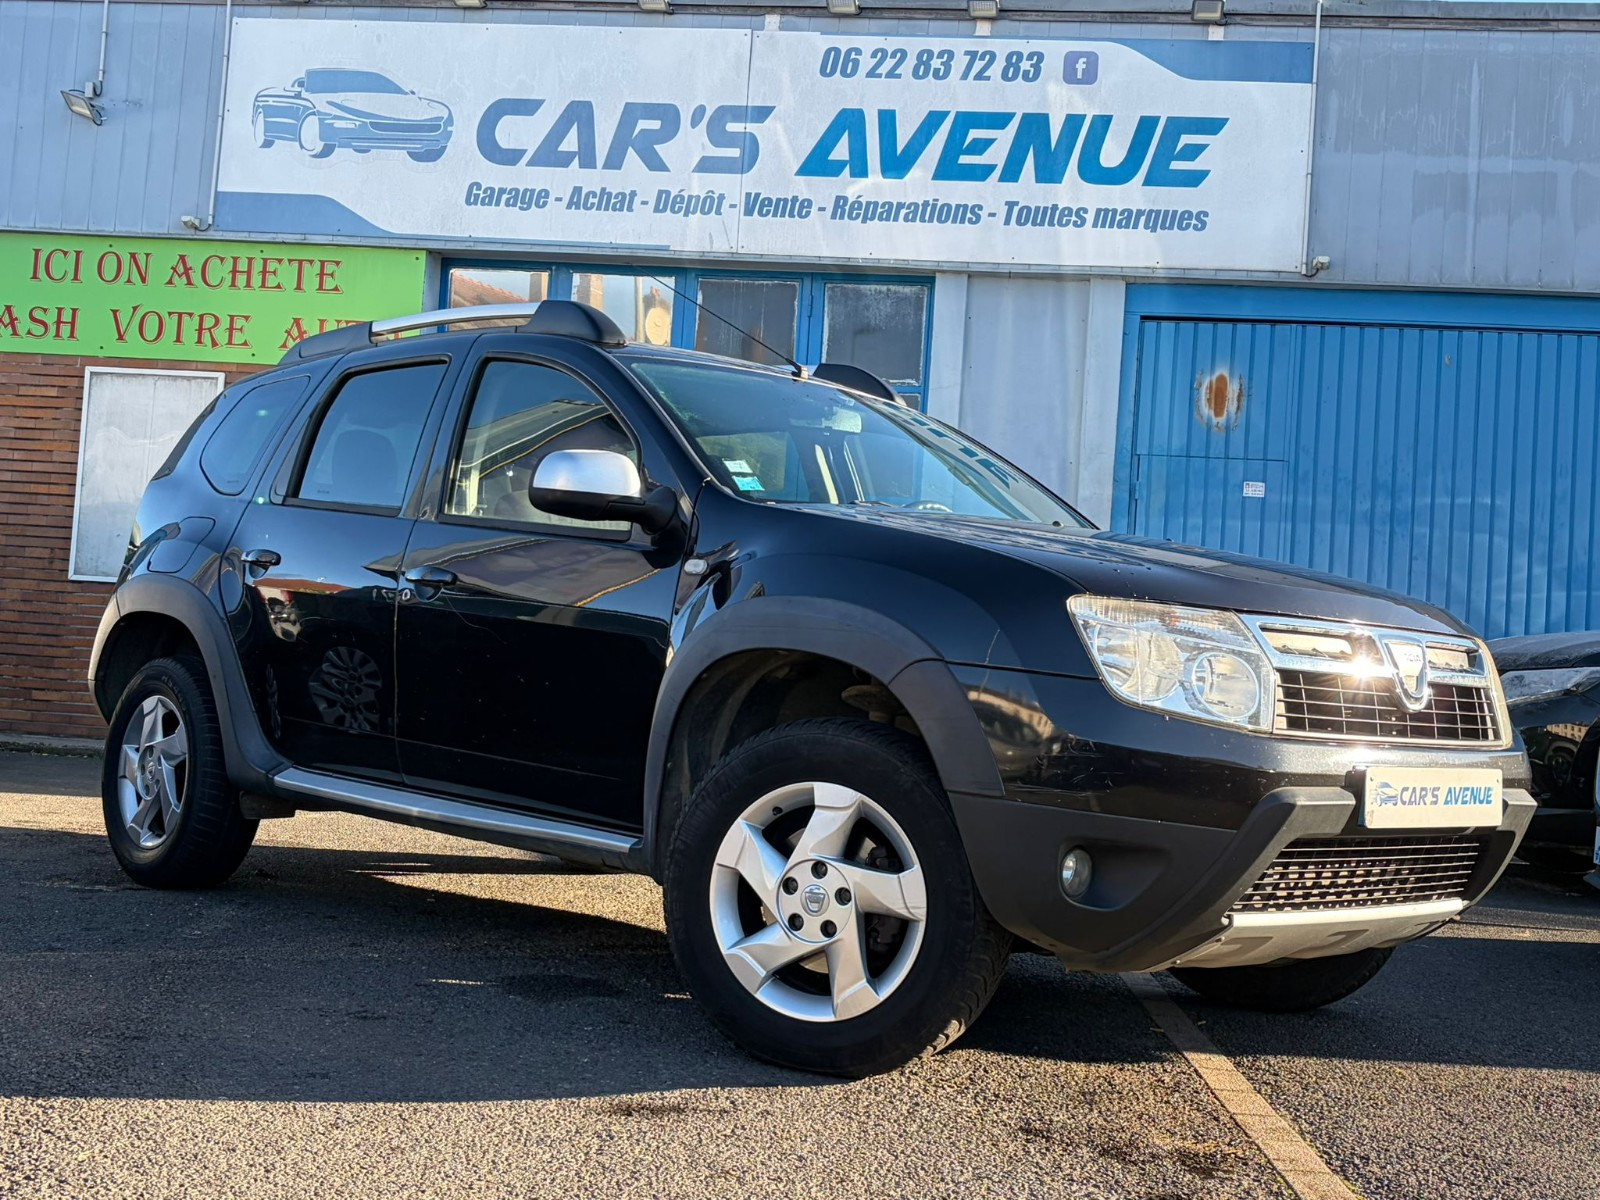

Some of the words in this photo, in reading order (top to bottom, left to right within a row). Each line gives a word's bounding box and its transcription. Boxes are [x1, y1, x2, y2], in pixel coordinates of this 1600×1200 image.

[819, 46, 863, 79] 06
[865, 47, 908, 80] 22
[911, 48, 956, 82] 83
[959, 50, 999, 83] 72
[1000, 50, 1046, 84] 83
[476, 97, 776, 174] CAR'S
[794, 107, 1230, 188] AVENUE
[465, 181, 550, 212] Garage
[566, 185, 637, 213] Achat
[653, 188, 725, 218] Dépôt
[743, 192, 813, 220] Vente
[830, 194, 983, 226] Réparations
[1003, 200, 1089, 229] Toutes
[1092, 208, 1210, 234] marques
[30, 248, 83, 284] ICI
[97, 251, 153, 286] ON
[164, 254, 344, 294] ACHETE
[110, 304, 253, 349] VOTRE
[1400, 786, 1440, 806] CAR'S
[1443, 786, 1493, 806] AVENUE
